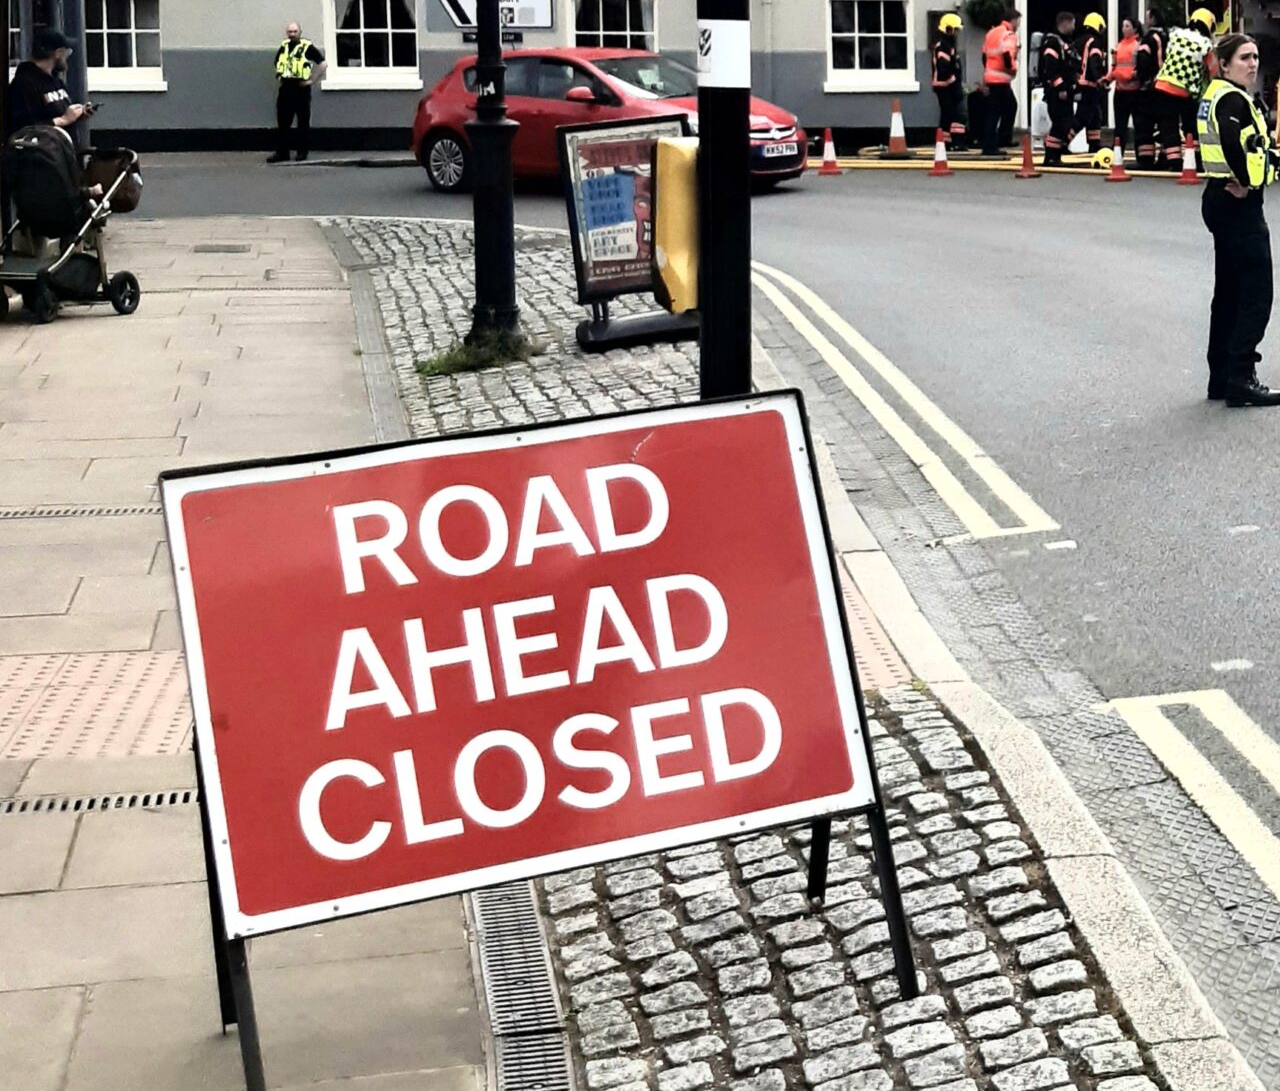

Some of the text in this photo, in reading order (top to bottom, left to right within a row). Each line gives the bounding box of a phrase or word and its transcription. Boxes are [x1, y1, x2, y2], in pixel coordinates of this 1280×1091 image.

[332, 462, 670, 595] ROAD
[324, 573, 729, 732] AHEAD
[298, 687, 783, 861] CLOSED
